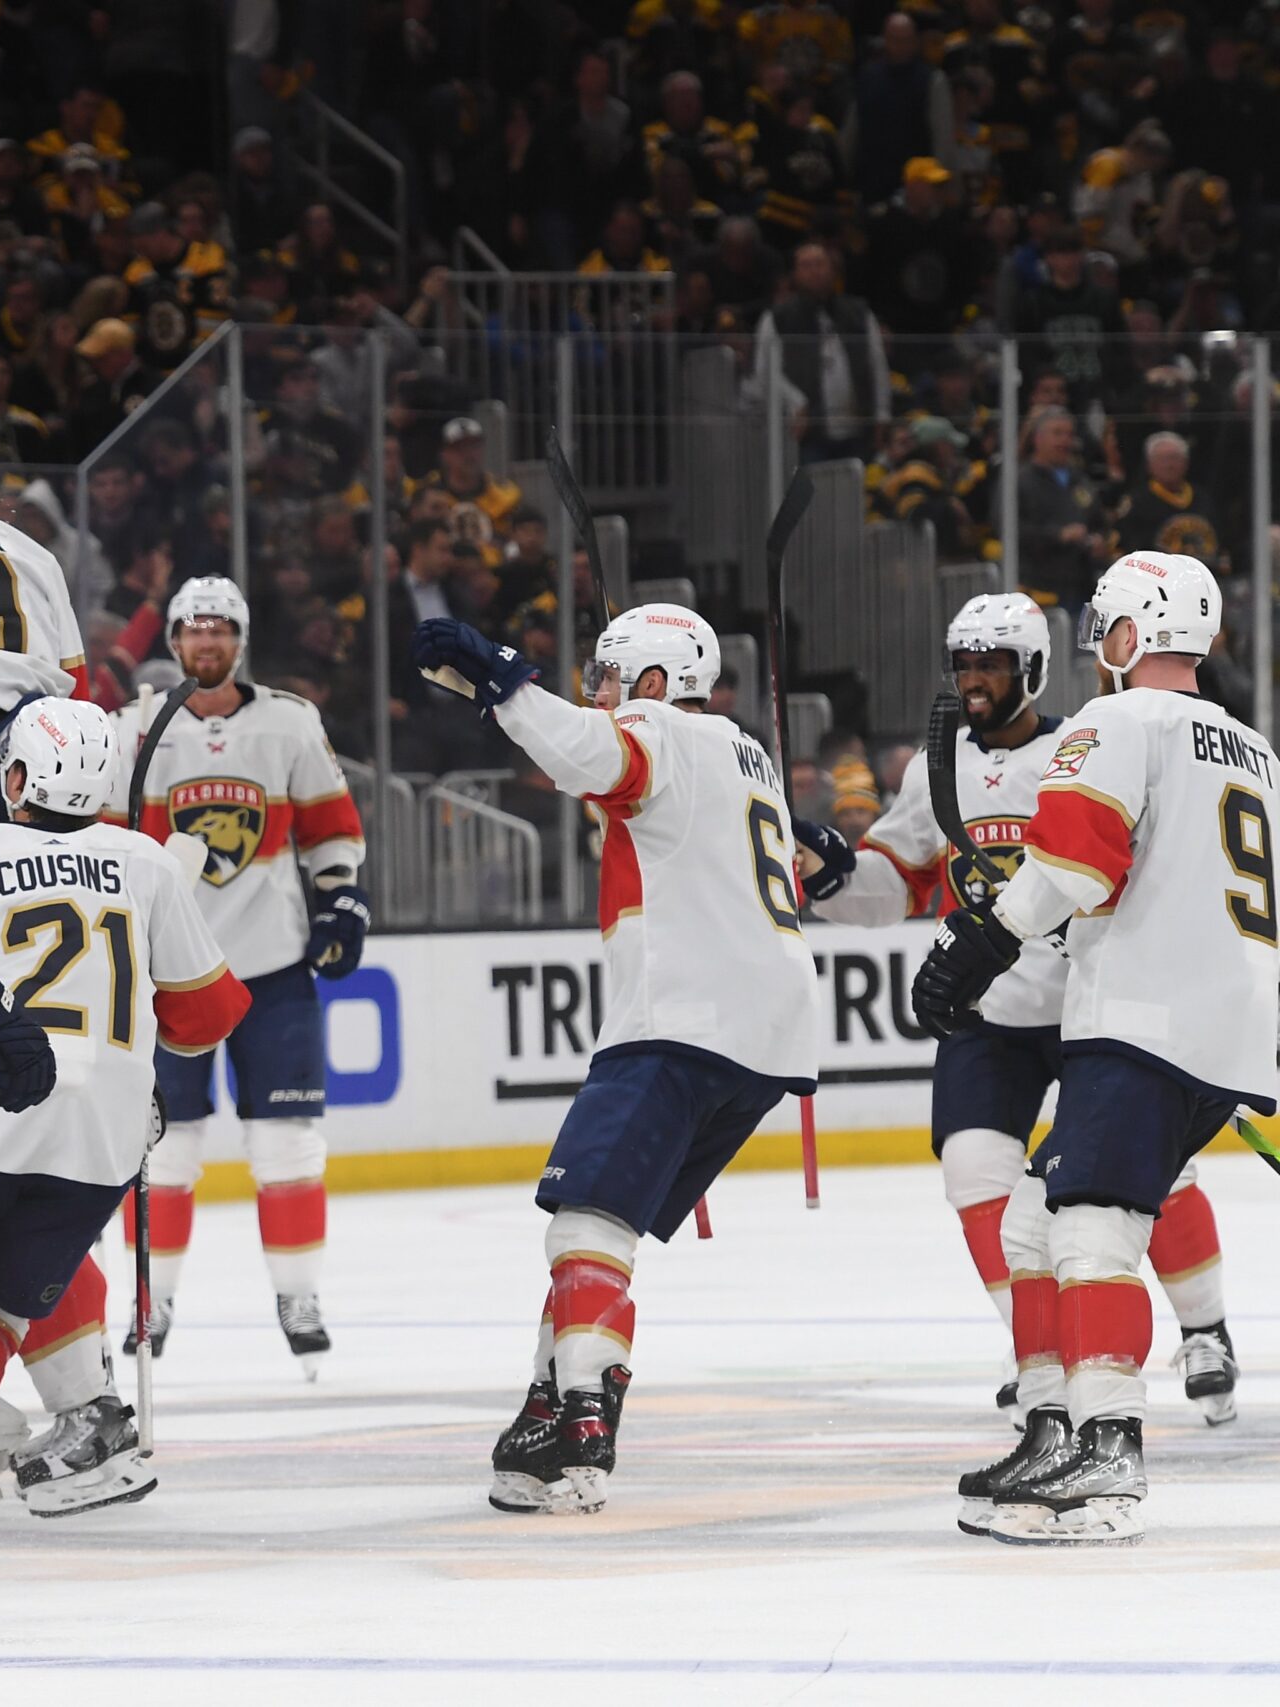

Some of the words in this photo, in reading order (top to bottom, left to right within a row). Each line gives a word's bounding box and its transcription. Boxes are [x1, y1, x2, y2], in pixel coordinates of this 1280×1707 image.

[1200, 598, 1210, 617] 9
[646, 615, 697, 630] AMERANT
[67, 793, 91, 808] 21
[176, 783, 258, 804] FLORIDA
[974, 823, 1023, 844] ORID
[744, 790, 805, 941] 6
[1218, 781, 1279, 949] 9
[1, 898, 138, 1053] 21
